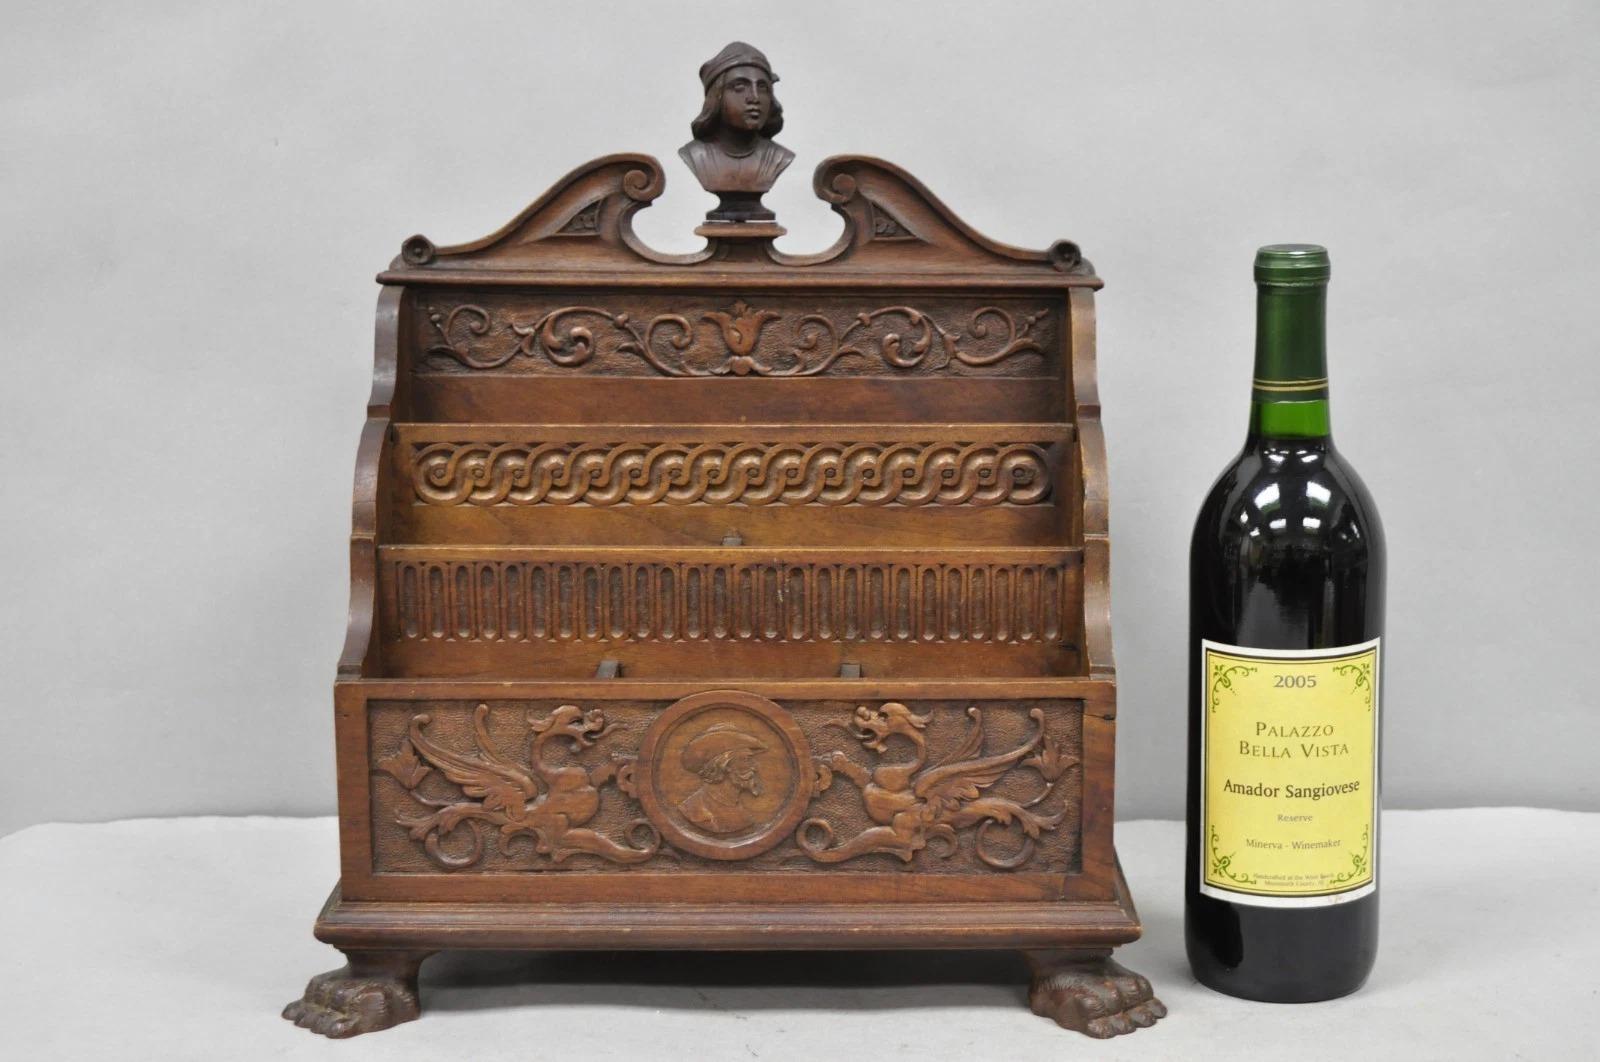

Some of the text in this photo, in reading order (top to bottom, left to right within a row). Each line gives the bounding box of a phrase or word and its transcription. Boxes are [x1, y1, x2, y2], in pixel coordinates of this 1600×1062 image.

[1273, 675, 1317, 688] 2005
[1256, 721, 1334, 738] PALAZZO
[1239, 740, 1349, 758] BELLA VISTA
[1223, 779, 1360, 801] Amador Sangiovese
[1277, 814, 1313, 822] Reserve
[1246, 838, 1283, 850] Minerva
[1291, 839, 1341, 850] Winemaker
